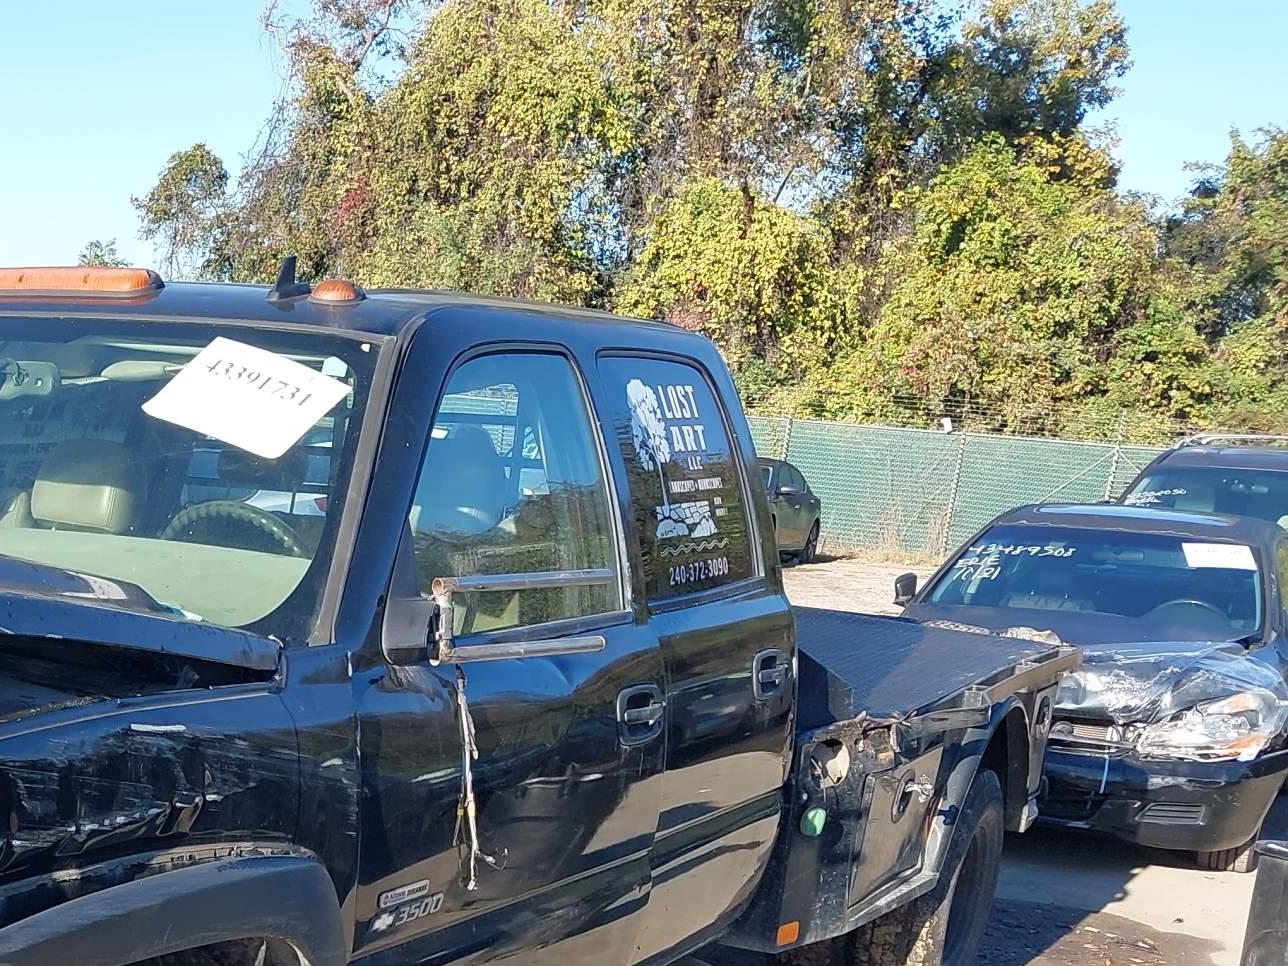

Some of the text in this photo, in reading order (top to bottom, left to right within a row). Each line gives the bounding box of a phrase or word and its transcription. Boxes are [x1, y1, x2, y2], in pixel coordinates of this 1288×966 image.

[205, 359, 313, 407] 43391731
[657, 385, 699, 419] LOST
[669, 425, 707, 452] ART
[687, 455, 703, 471] LLC
[954, 554, 1001, 568] ERIE
[968, 543, 1076, 557] 43489508
[669, 556, 729, 586] 240-372-3090
[394, 891, 444, 926] 3500
